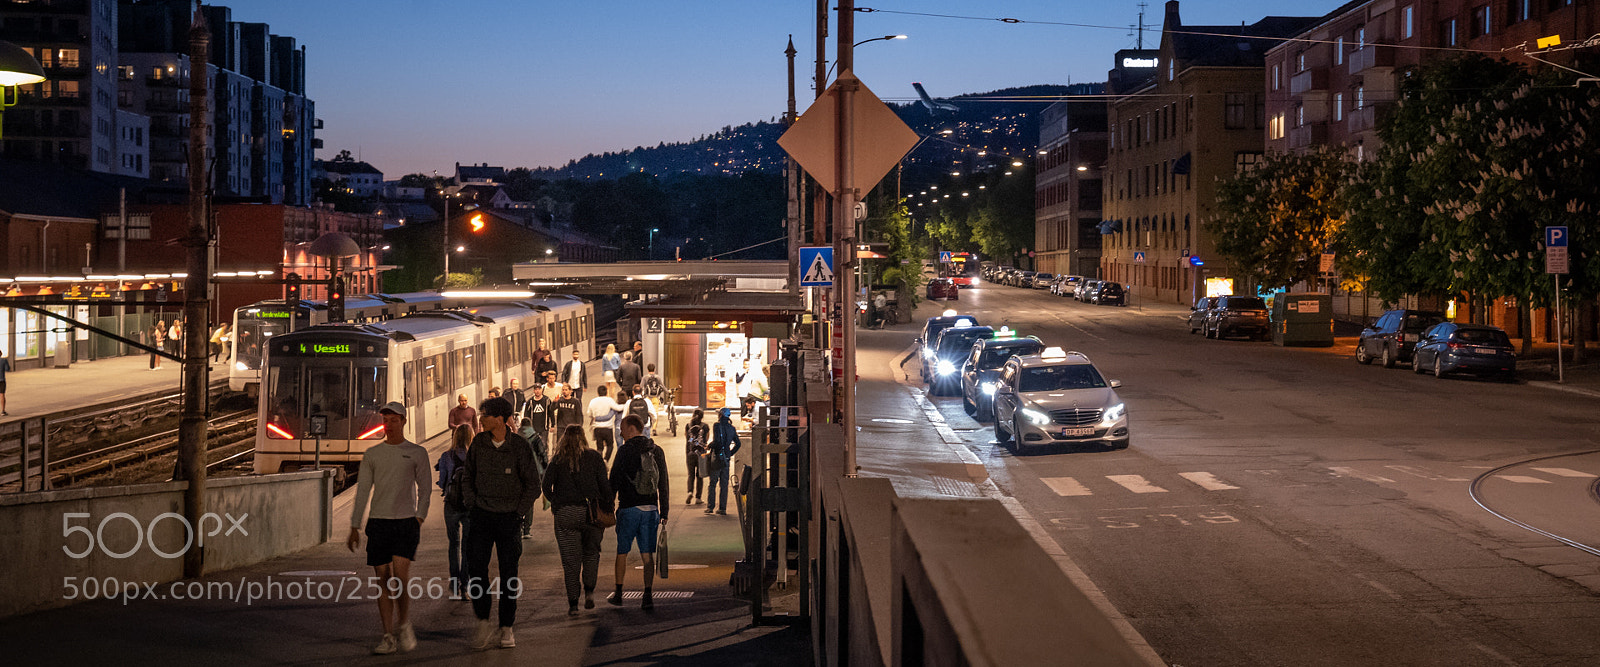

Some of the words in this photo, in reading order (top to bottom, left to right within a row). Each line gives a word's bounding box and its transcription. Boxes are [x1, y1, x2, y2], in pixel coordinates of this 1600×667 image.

[1551, 229, 1563, 245] P
[650, 319, 658, 329] 2
[300, 343, 306, 353] 4
[313, 344, 350, 353] Vestli
[315, 424, 321, 433] 2
